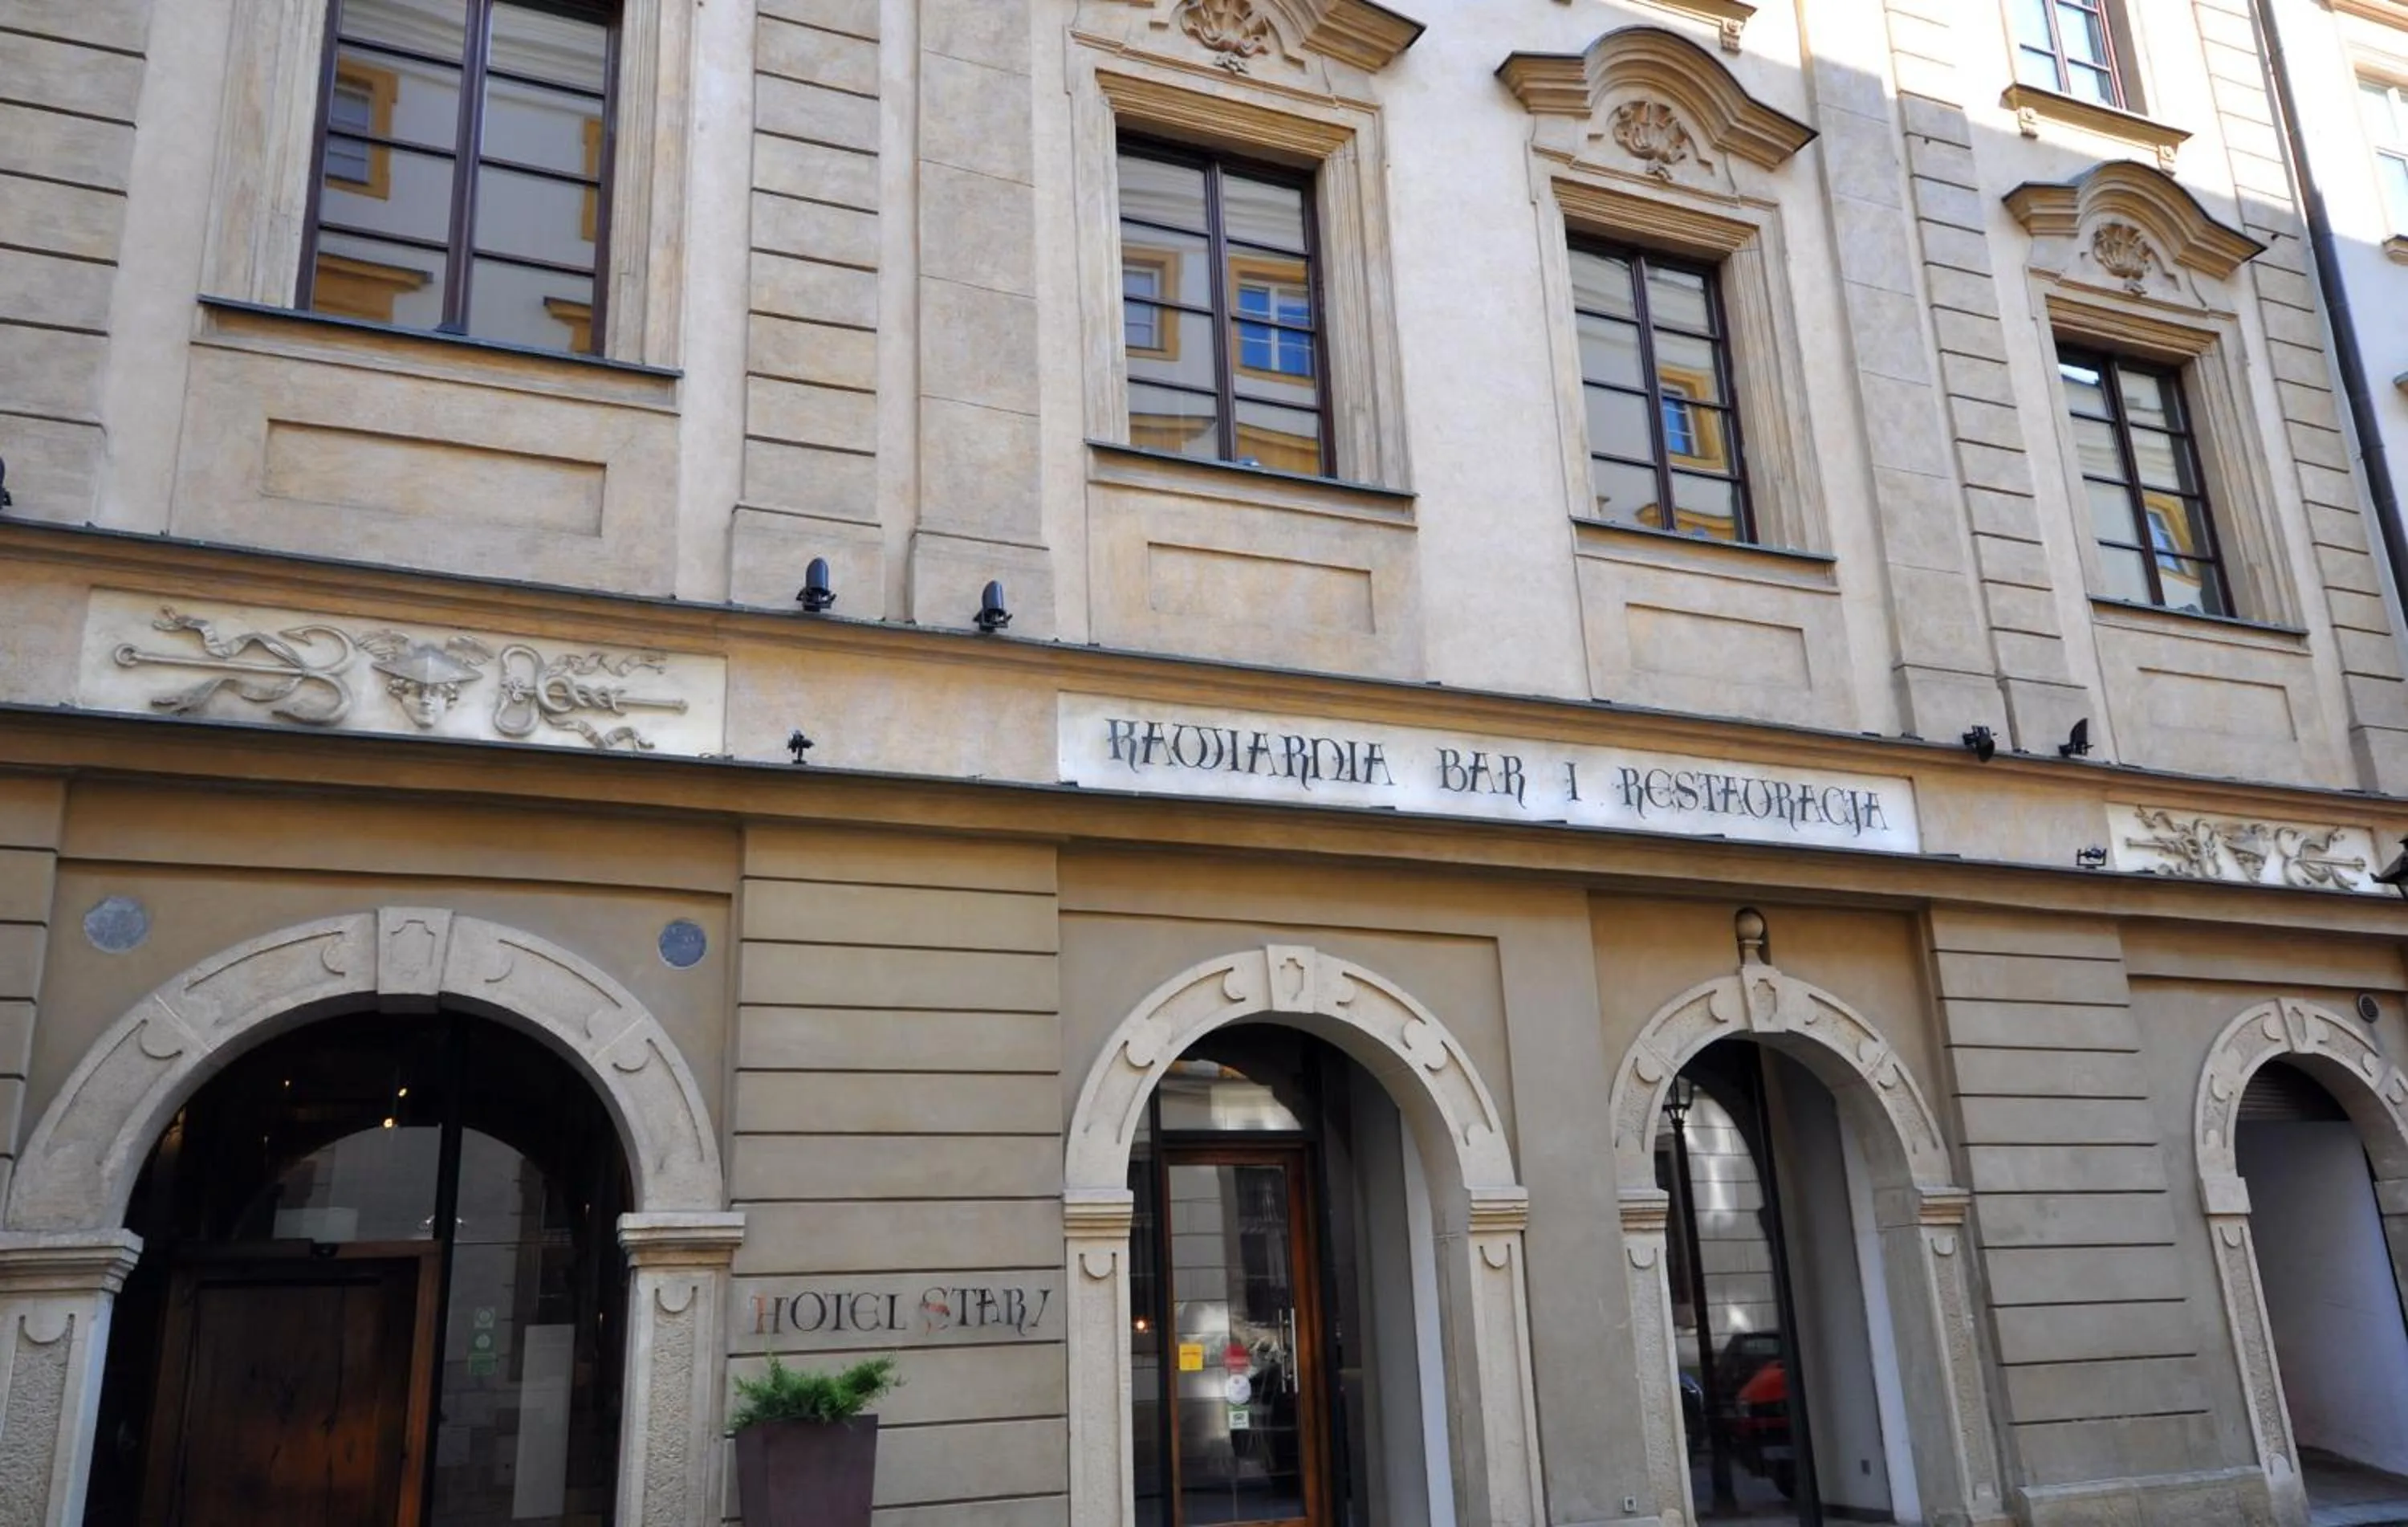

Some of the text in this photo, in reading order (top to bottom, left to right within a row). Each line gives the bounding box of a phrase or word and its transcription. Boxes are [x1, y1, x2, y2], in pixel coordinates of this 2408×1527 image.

[1436, 747, 1527, 810] BAR
[1564, 761, 1583, 803] I
[1617, 767, 1889, 837] RESTAURACJA
[750, 1290, 907, 1335] HOTEL
